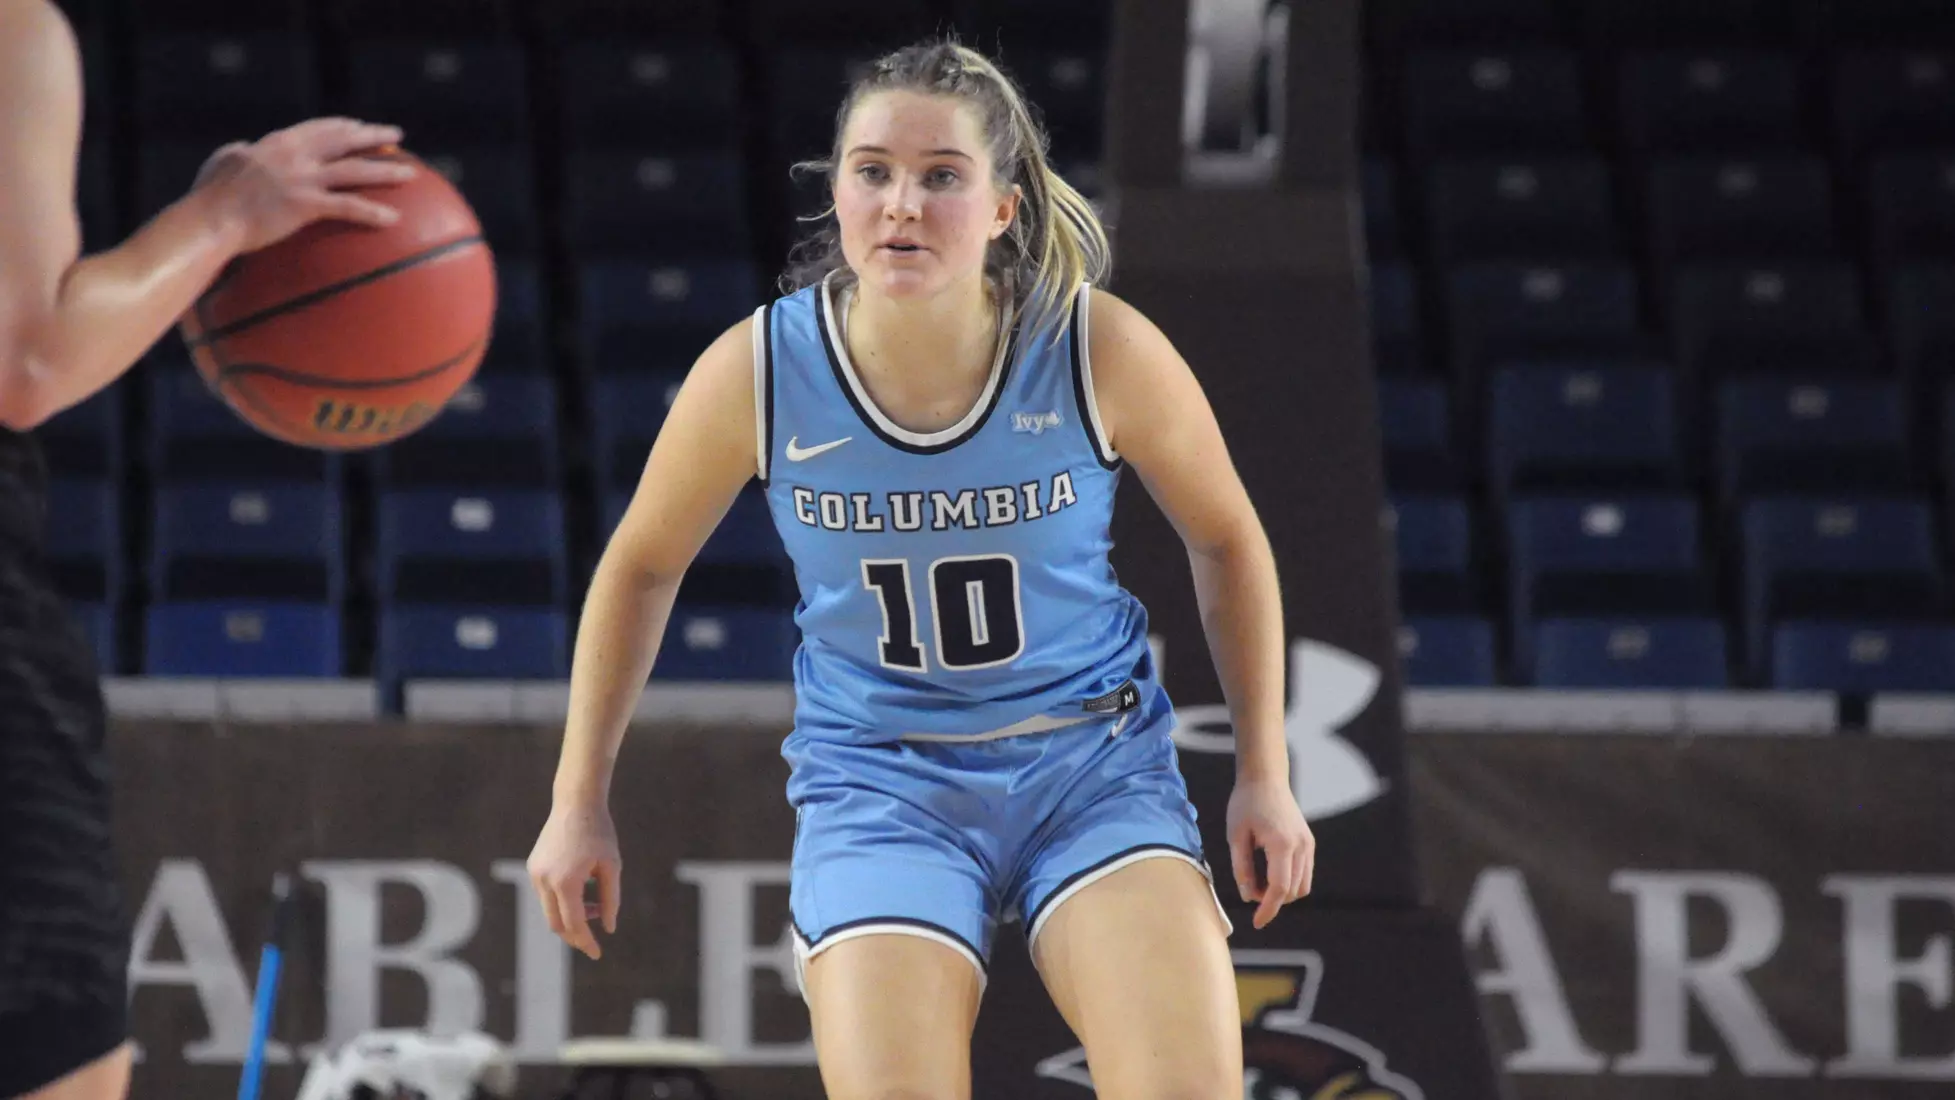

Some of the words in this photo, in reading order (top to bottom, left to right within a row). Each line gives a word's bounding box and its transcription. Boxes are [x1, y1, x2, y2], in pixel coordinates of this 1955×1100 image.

[792, 471, 1078, 532] COLUMBIA
[860, 553, 1025, 674] 10
[1123, 690, 1135, 707] M
